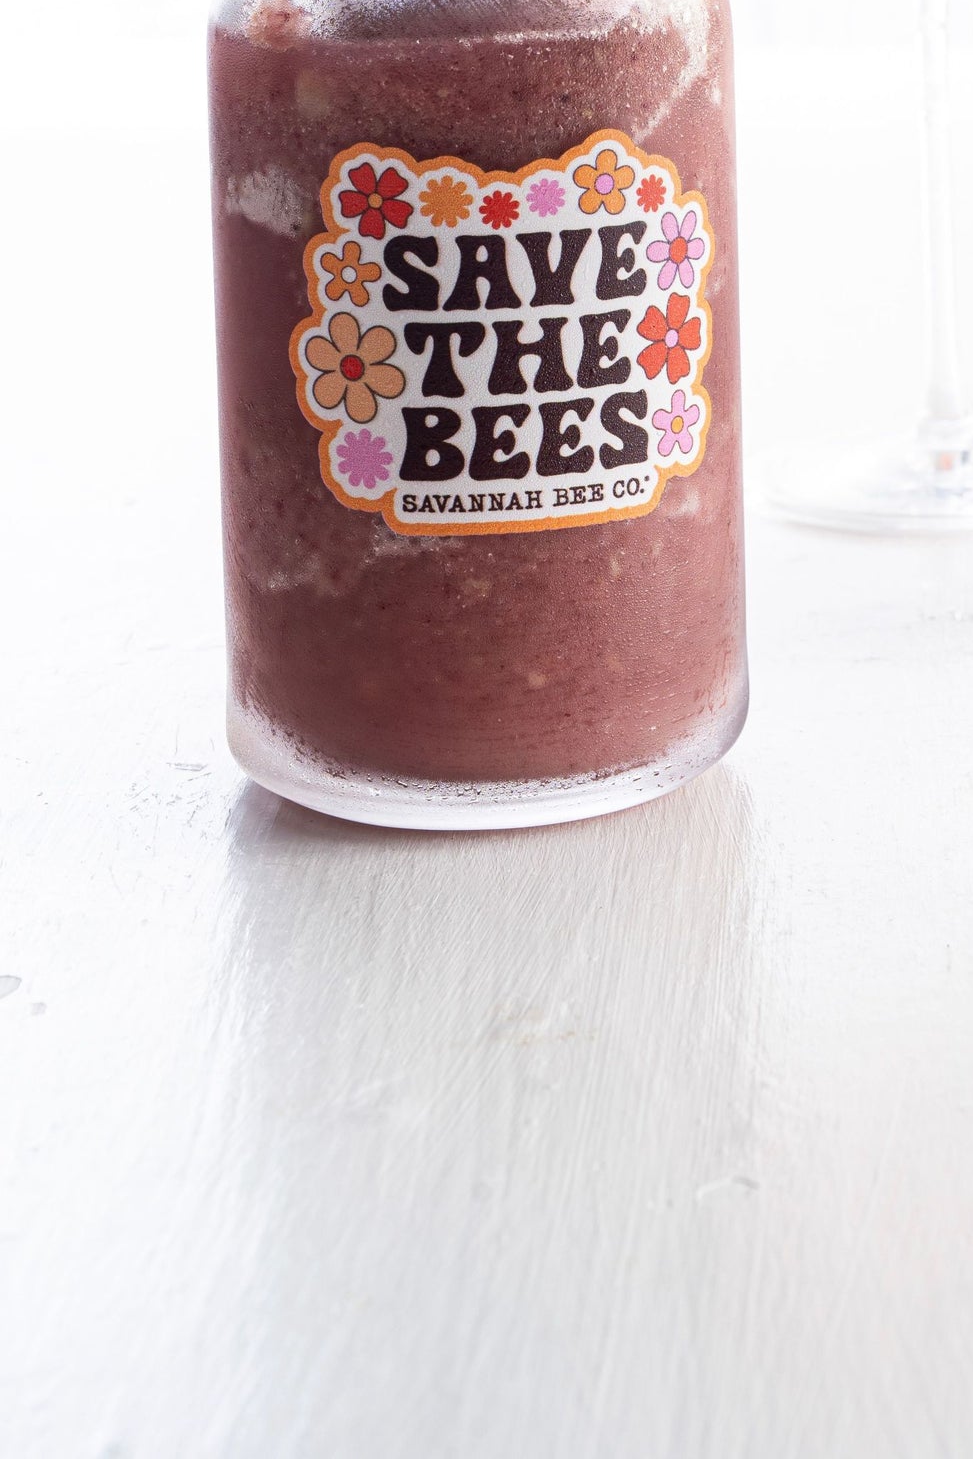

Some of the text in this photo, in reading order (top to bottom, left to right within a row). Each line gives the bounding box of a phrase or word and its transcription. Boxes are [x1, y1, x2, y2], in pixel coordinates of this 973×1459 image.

[382, 220, 647, 312] SAVE
[404, 308, 632, 398] THE
[399, 389, 648, 481] BEES
[402, 490, 543, 514] SAVANNAH
[552, 483, 604, 507] BEE
